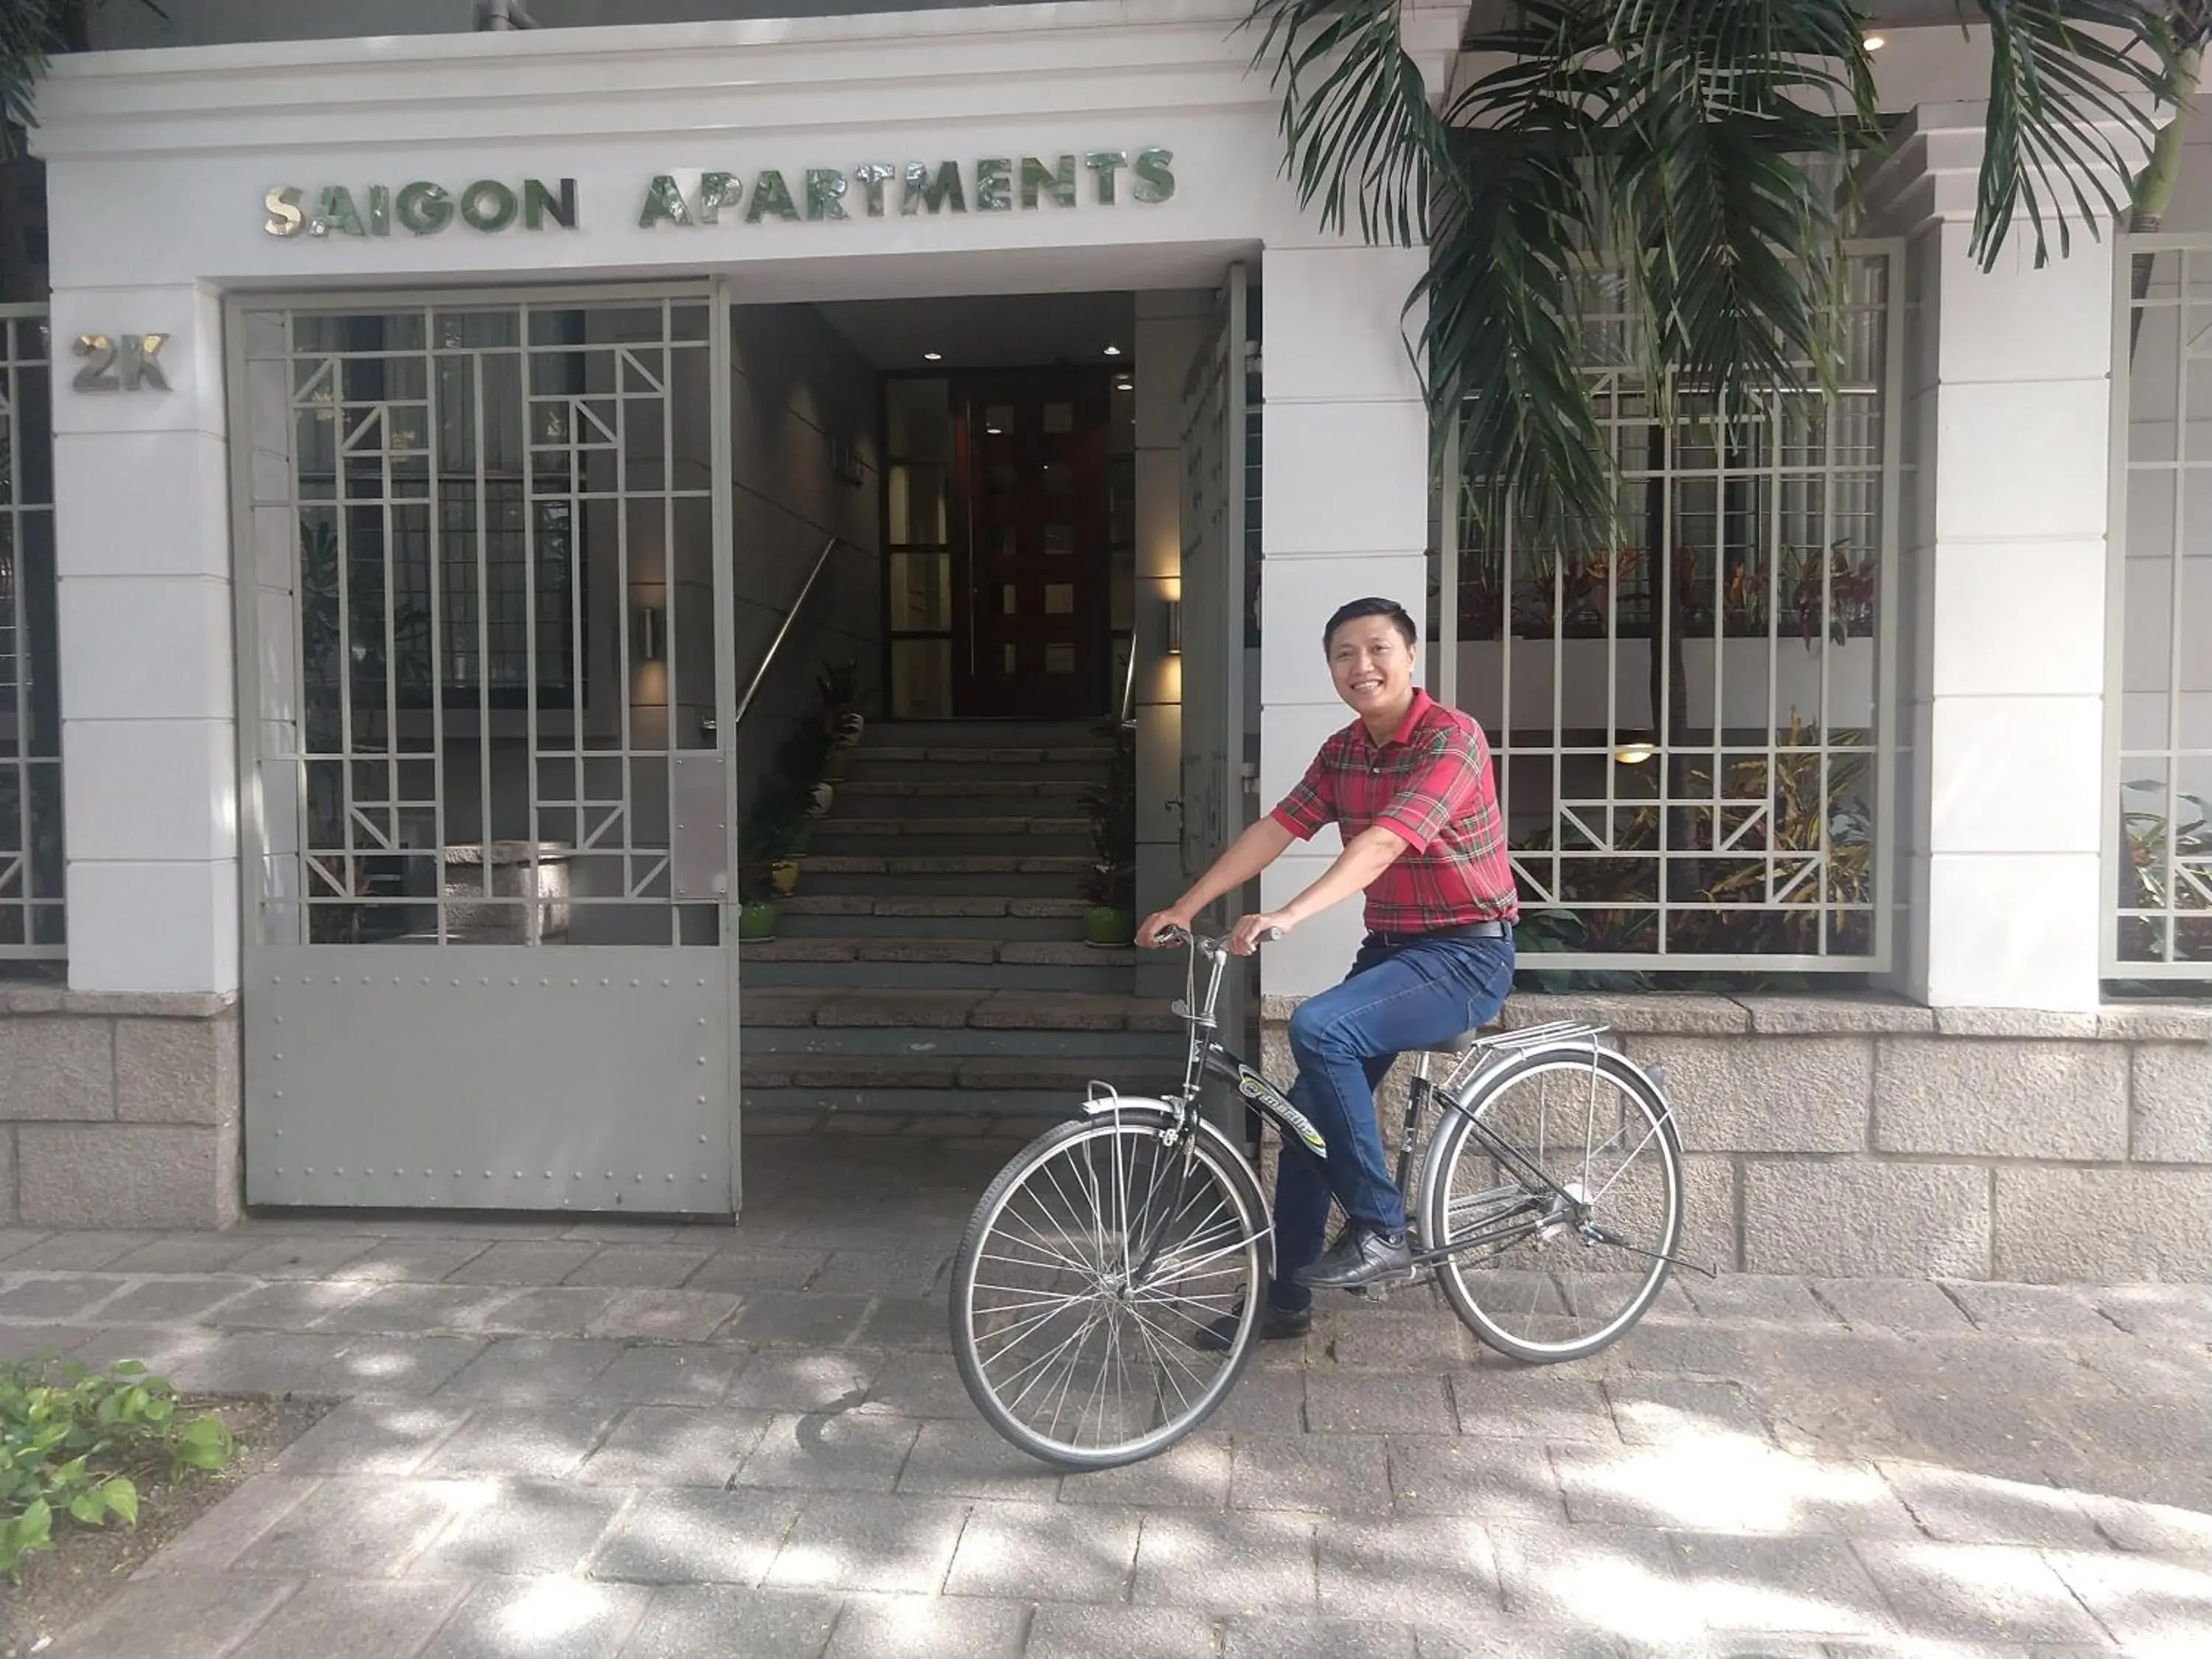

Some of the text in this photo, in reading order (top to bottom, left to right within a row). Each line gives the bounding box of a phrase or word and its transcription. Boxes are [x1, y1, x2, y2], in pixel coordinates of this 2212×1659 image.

[264, 148, 1176, 237] SAIGON APARTMENTS
[72, 332, 173, 392] 2K
